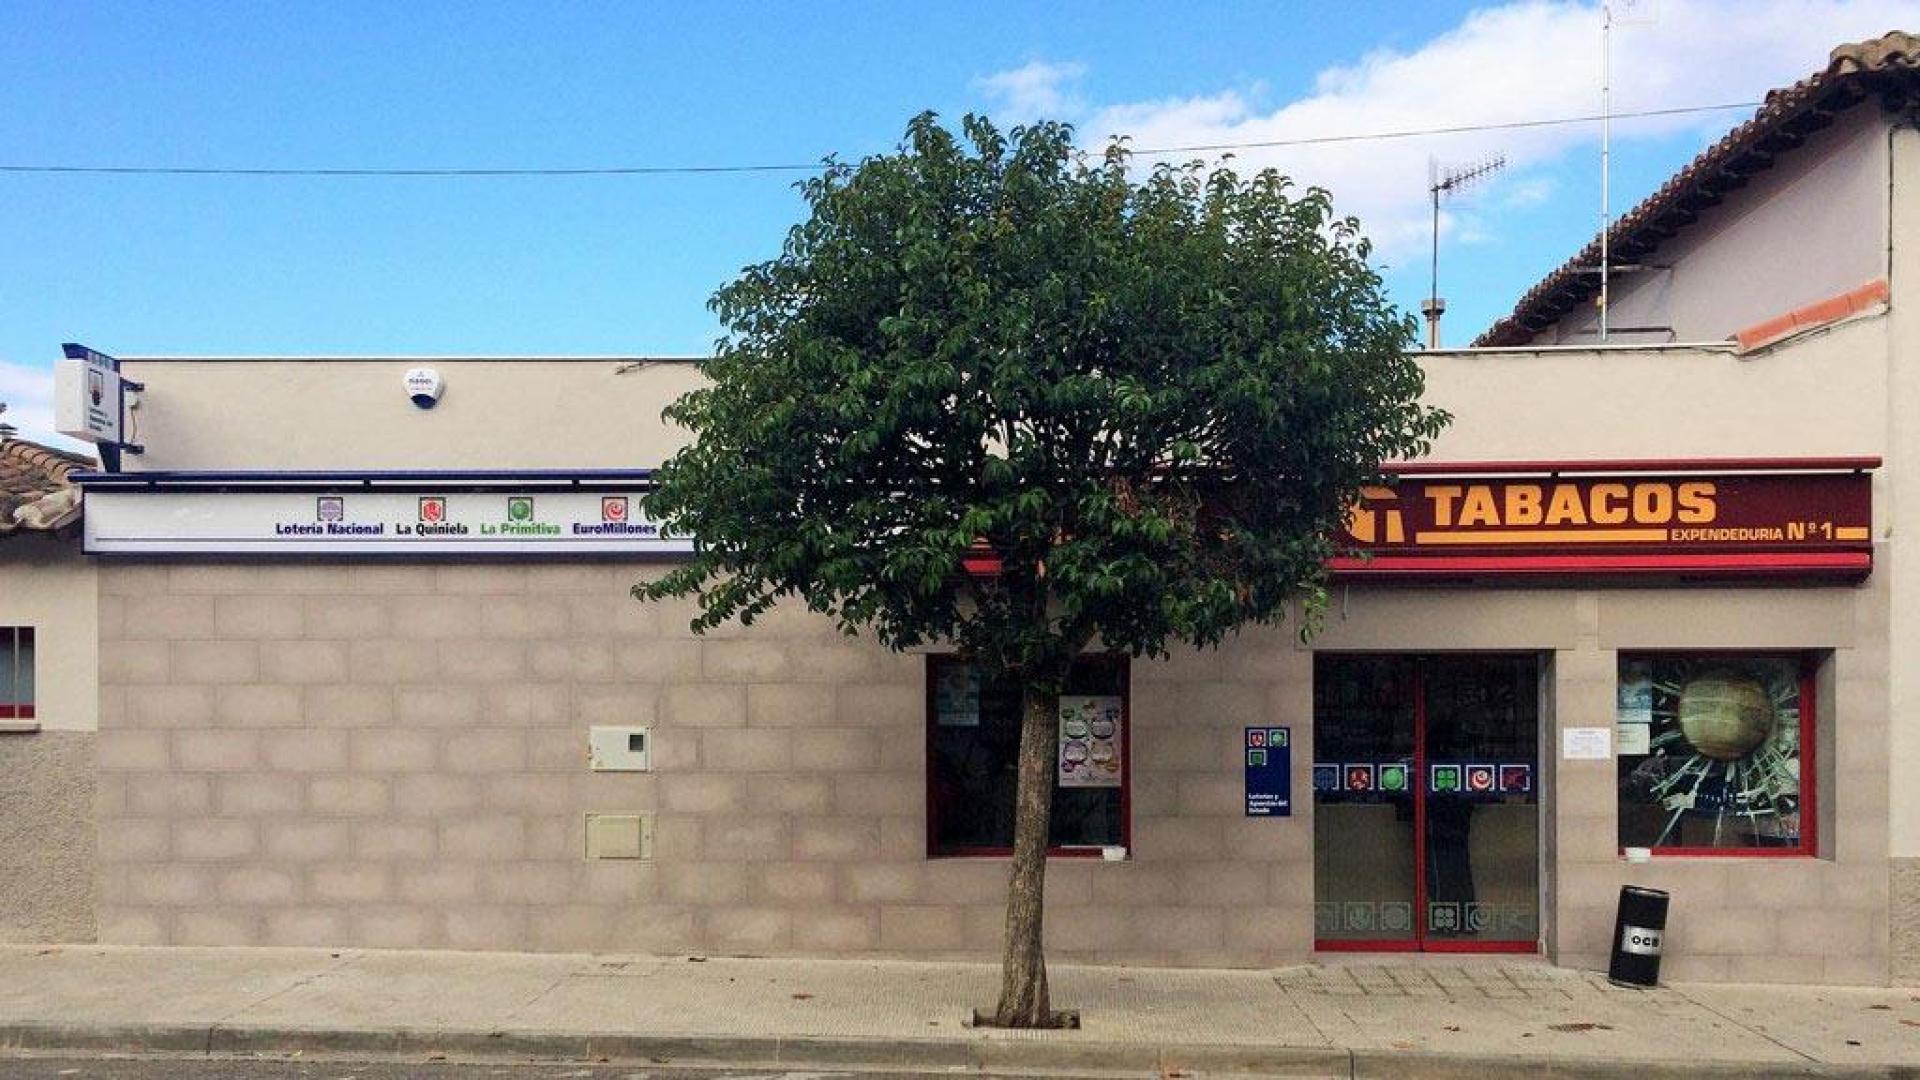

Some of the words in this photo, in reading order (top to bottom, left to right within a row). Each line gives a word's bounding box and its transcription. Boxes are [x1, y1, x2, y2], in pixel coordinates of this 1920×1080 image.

[1424, 483, 1717, 526] TABACOS
[327, 522, 384, 535] Nacional
[396, 523, 411, 535] La
[416, 522, 469, 537] Quiniela
[480, 523, 495, 535] La
[501, 522, 561, 535] Primitiva
[573, 522, 657, 535] EuroMillones
